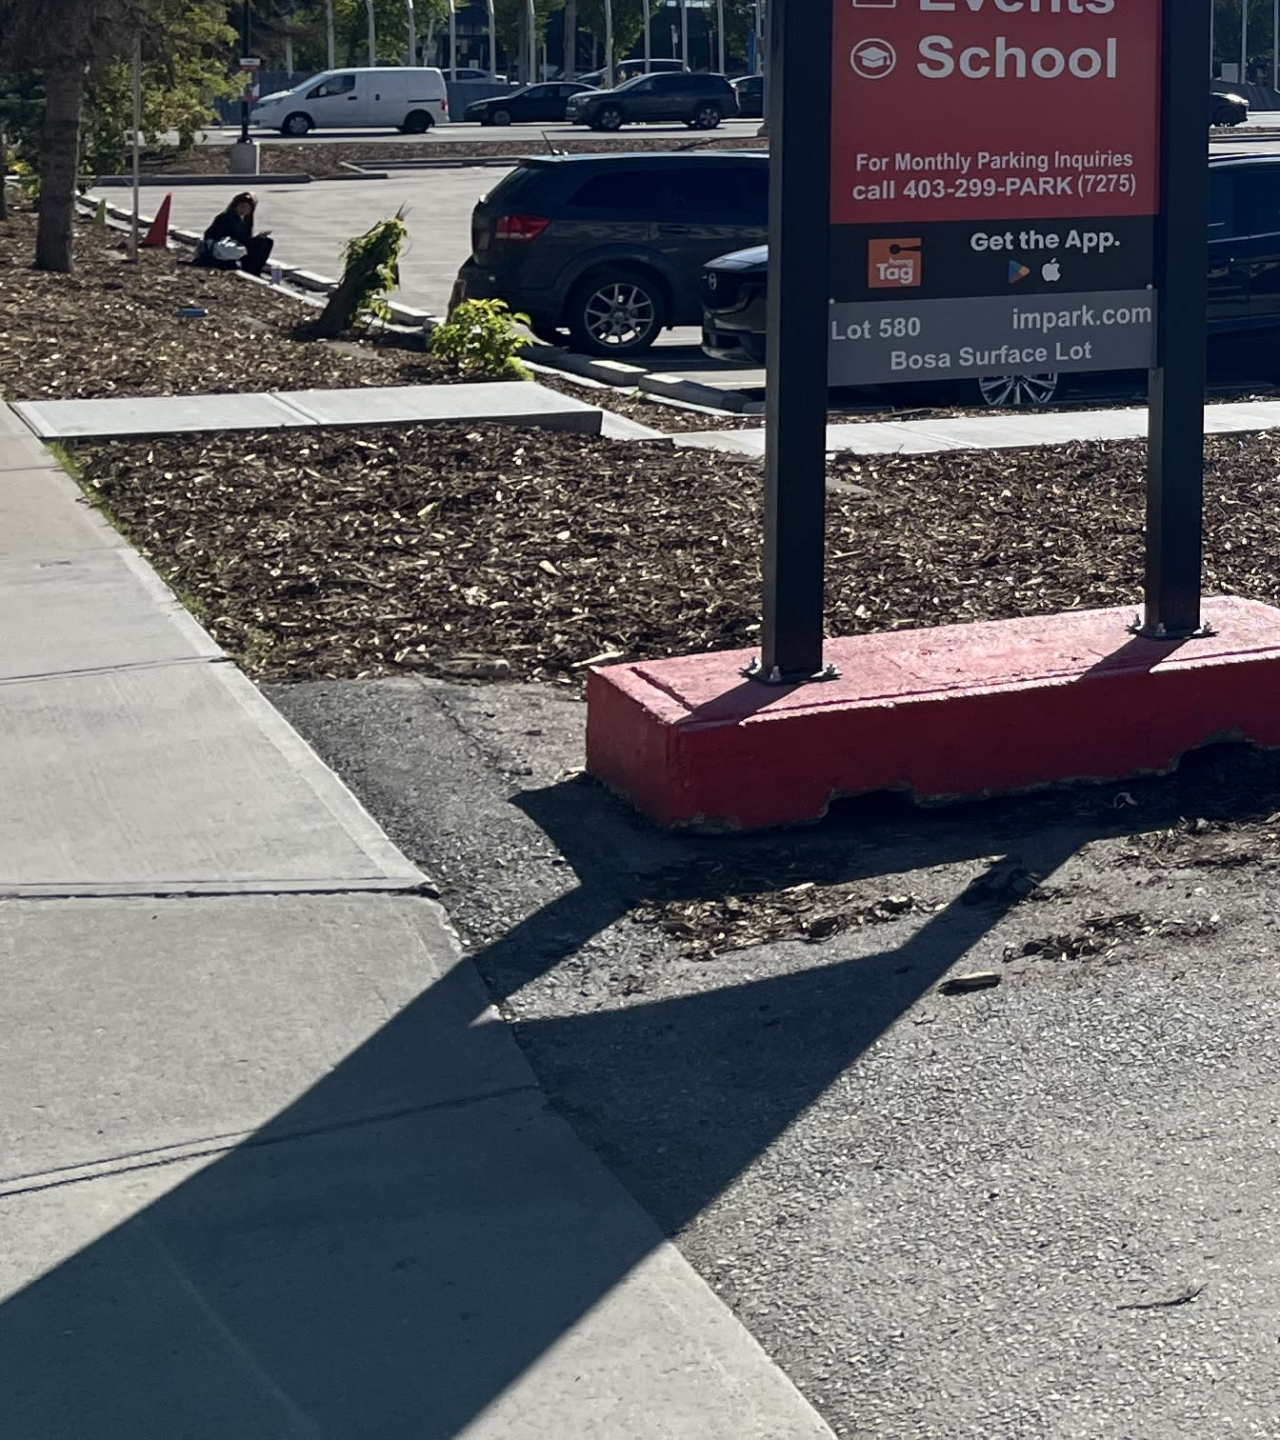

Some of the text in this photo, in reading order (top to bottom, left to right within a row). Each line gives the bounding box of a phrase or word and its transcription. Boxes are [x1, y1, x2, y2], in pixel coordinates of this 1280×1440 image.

[917, 35, 1117, 79] School
[856, 149, 1134, 175] For Monthly Parking Inquiries
[852, 173, 1137, 200] call 403-299-PARK (7275)
[970, 229, 1121, 254] Get the App.
[876, 262, 914, 285] Tag
[831, 316, 921, 340] Lot 580
[1012, 304, 1152, 333] impark.com
[890, 341, 1093, 370] Bosa Surface Lot
